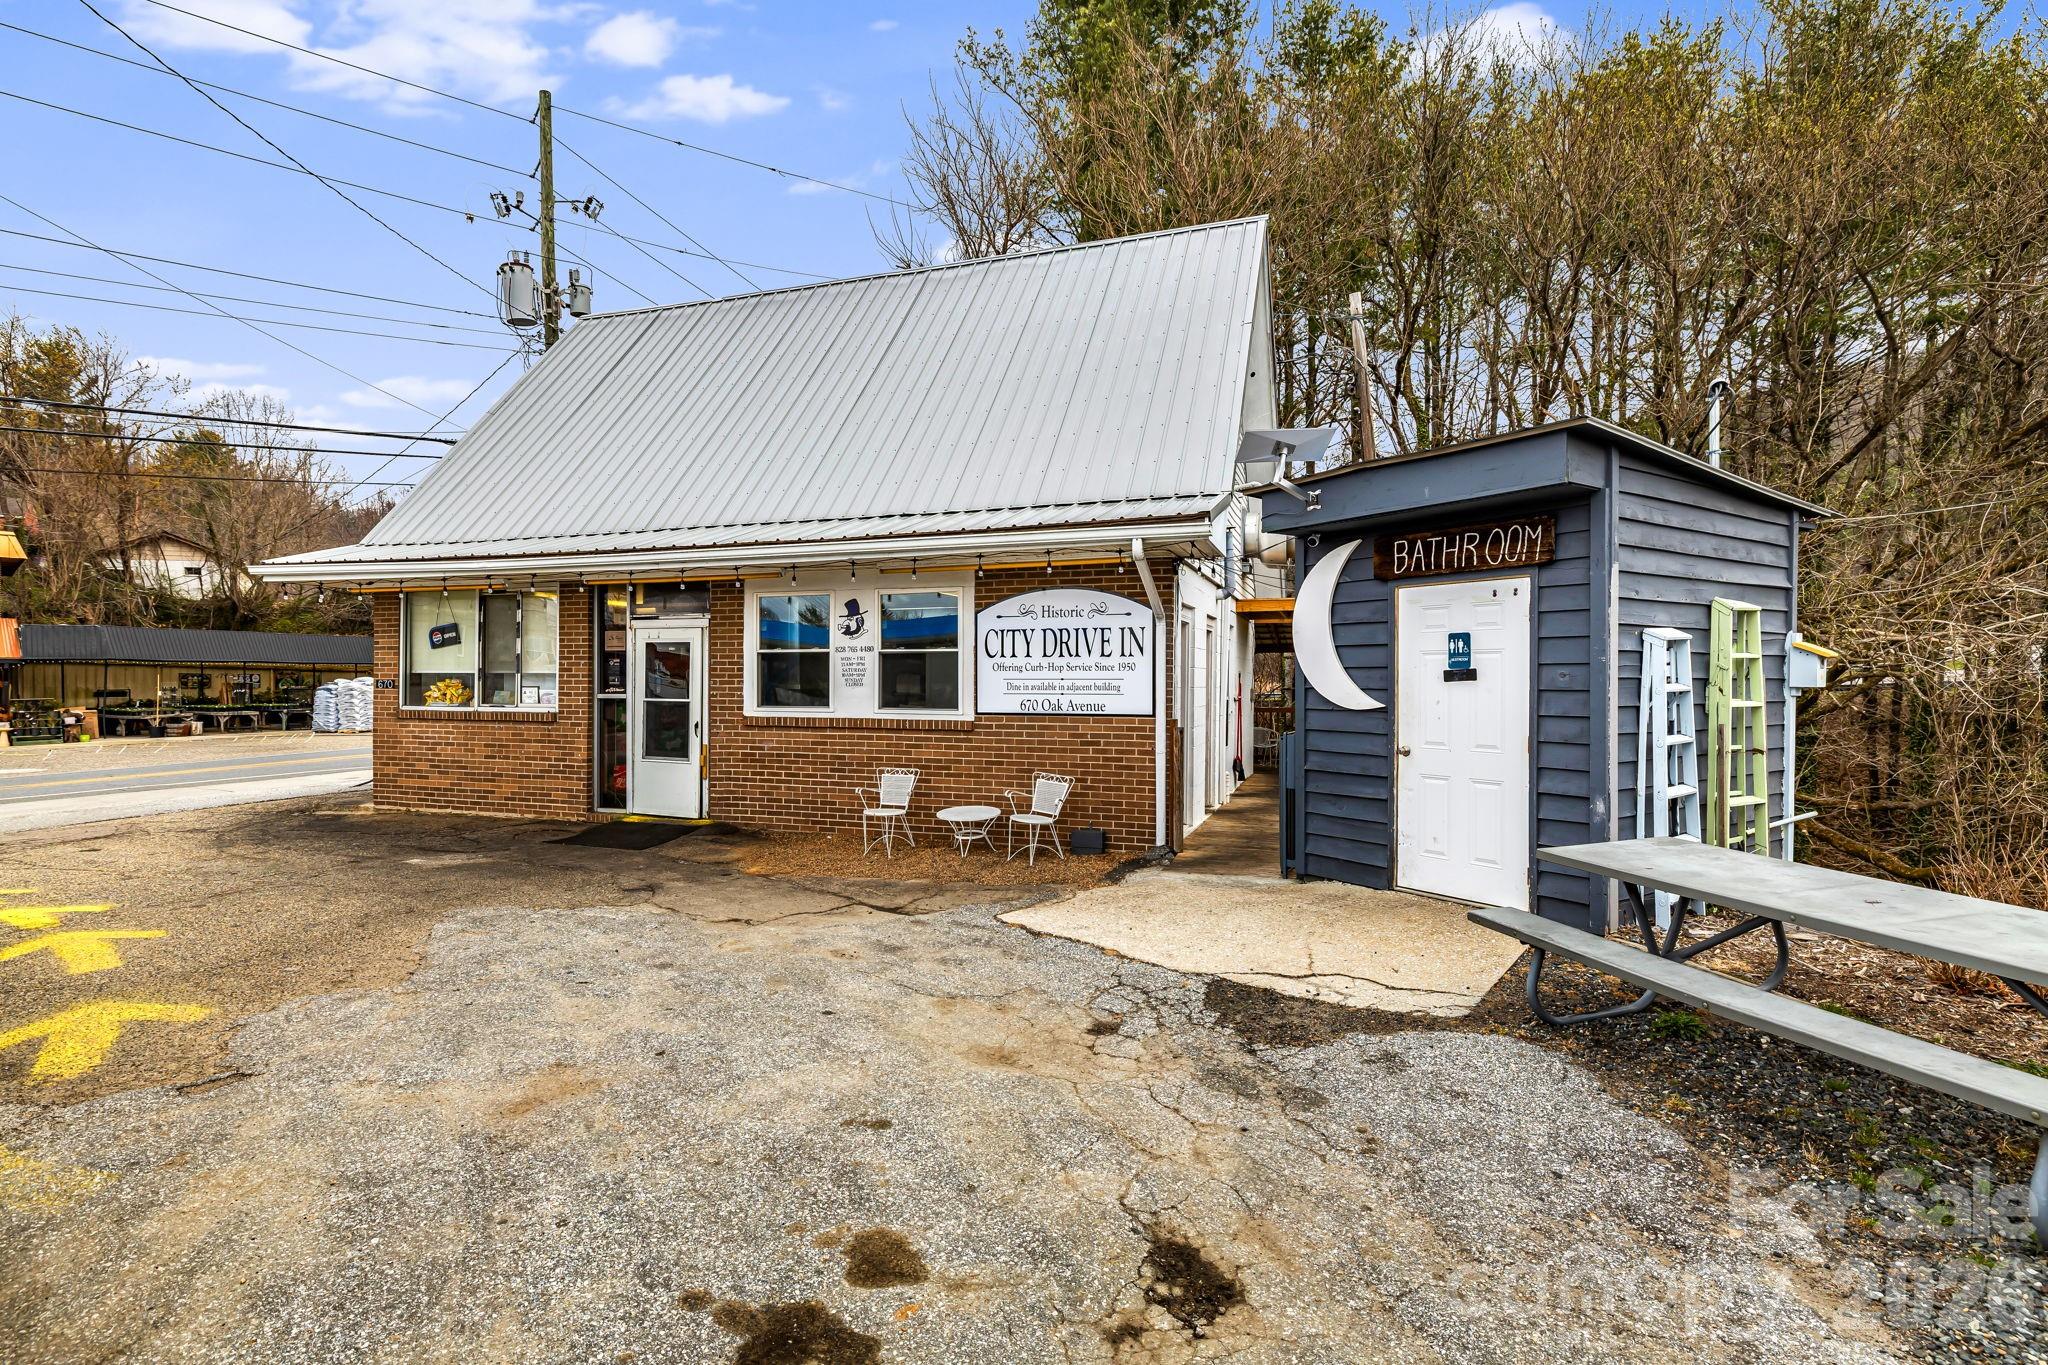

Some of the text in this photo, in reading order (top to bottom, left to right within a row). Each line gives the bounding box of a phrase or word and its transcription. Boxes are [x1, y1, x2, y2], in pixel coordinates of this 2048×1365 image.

[1394, 524, 1542, 574] BATHROOM
[1041, 605, 1085, 619] Historic
[984, 626, 1146, 659] CITY DRIVE IN
[992, 662, 1136, 673] Offering Curb-Hop Service Since 1950
[377, 680, 393, 689] 670
[1006, 682, 1121, 692] Dine in available in adjacent building
[1020, 698, 1106, 712] 670 Oak Avenue
